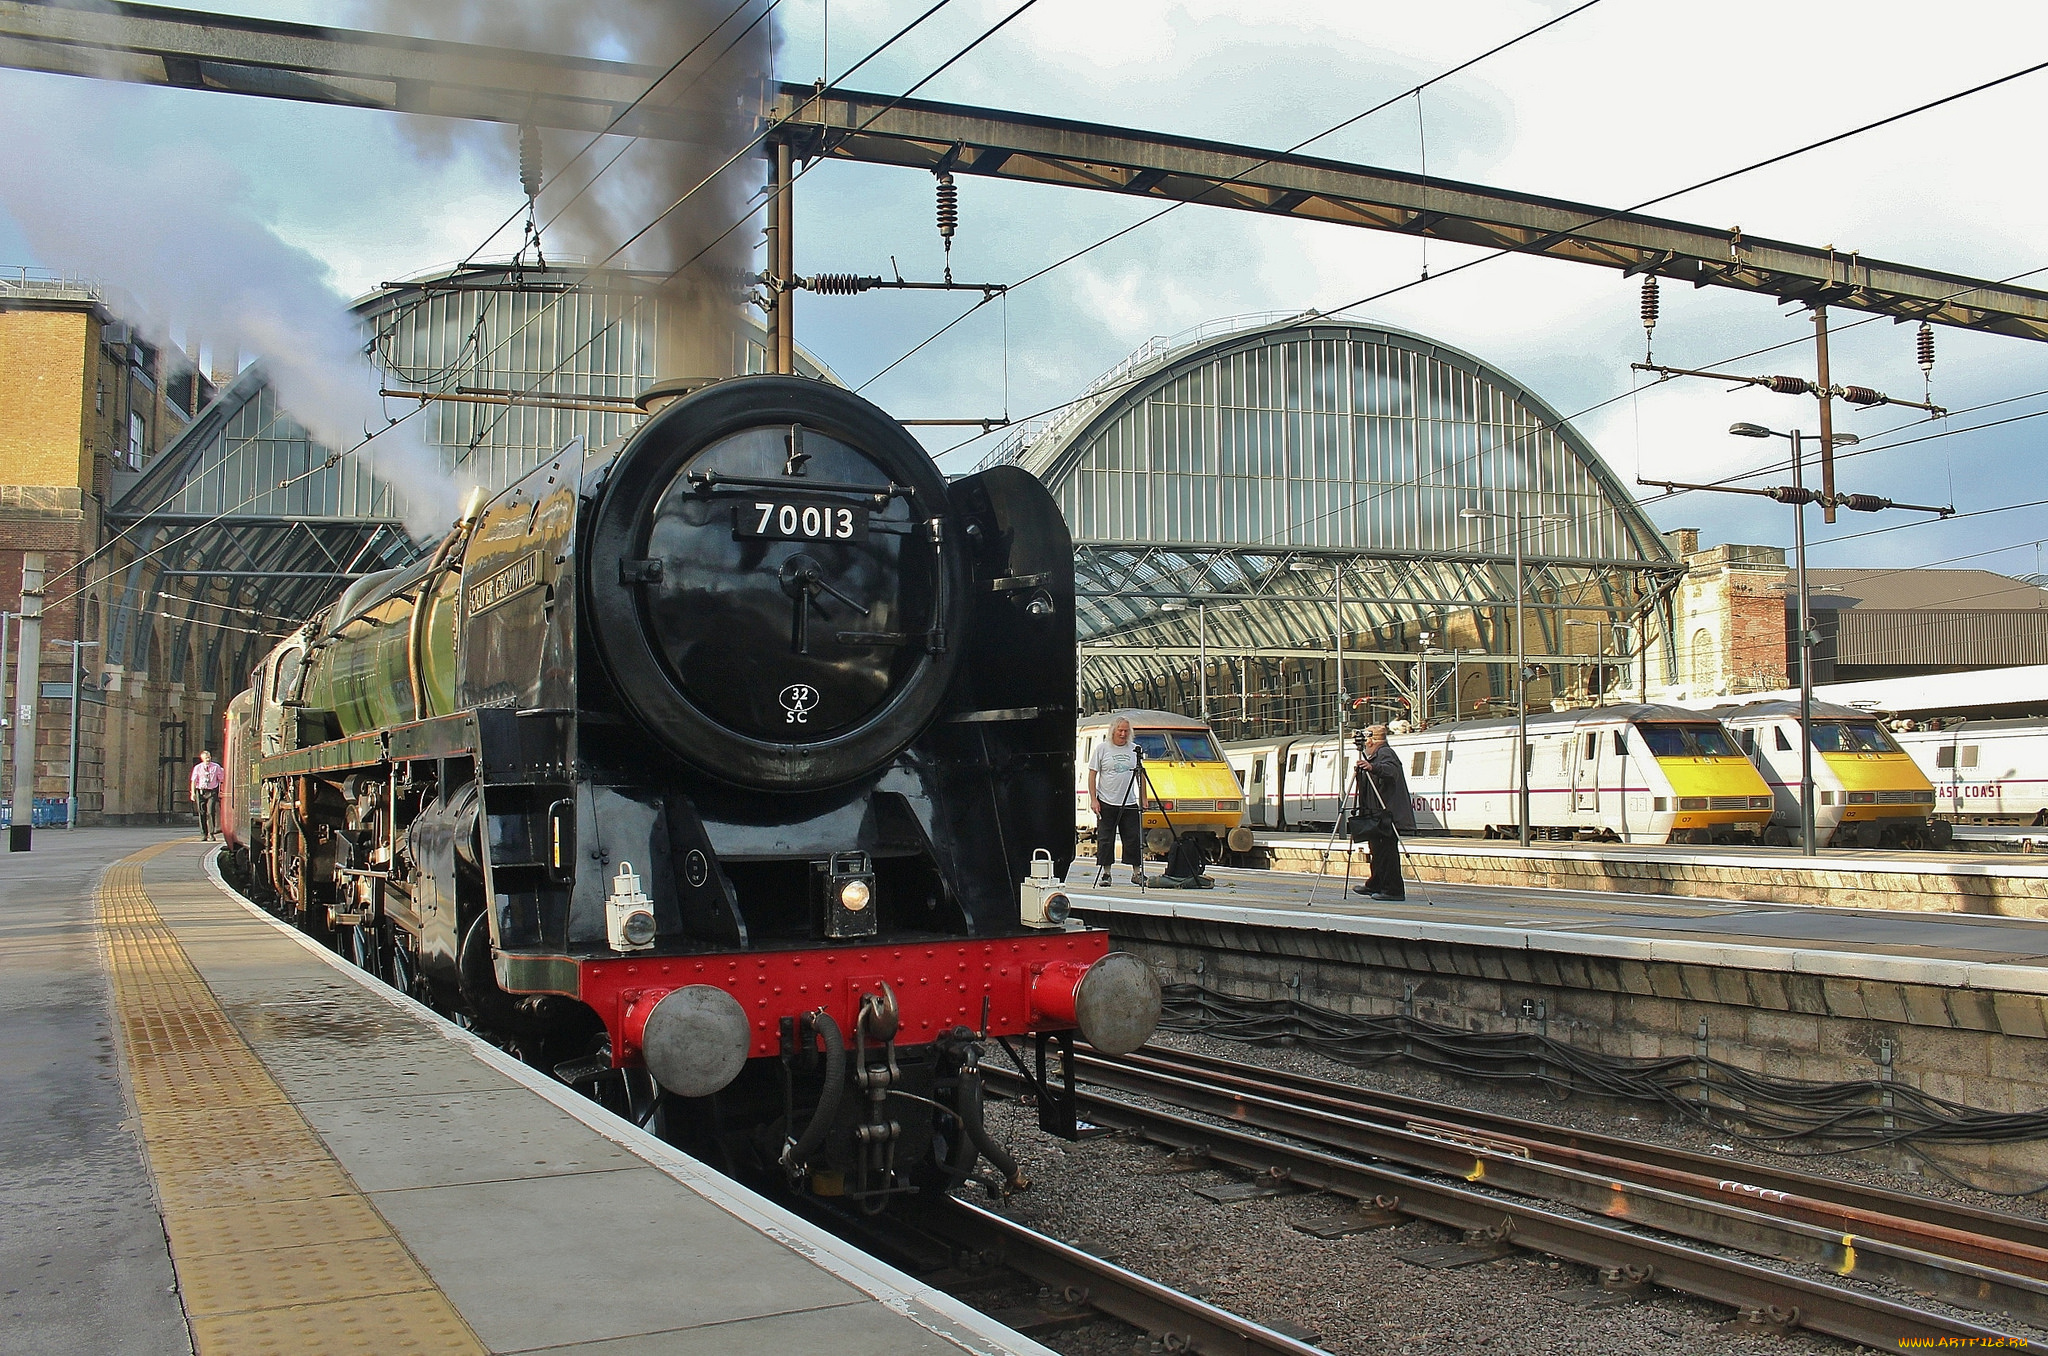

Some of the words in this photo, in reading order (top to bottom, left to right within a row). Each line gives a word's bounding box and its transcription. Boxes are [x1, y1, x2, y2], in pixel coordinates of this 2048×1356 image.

[755, 502, 854, 539] 70013
[791, 687, 809, 700] 32
[794, 699, 803, 710] A
[1965, 785, 2002, 798] COAST
[1411, 797, 1426, 812] AST
[1429, 797, 1457, 812] COAST
[1771, 810, 1787, 820] 02
